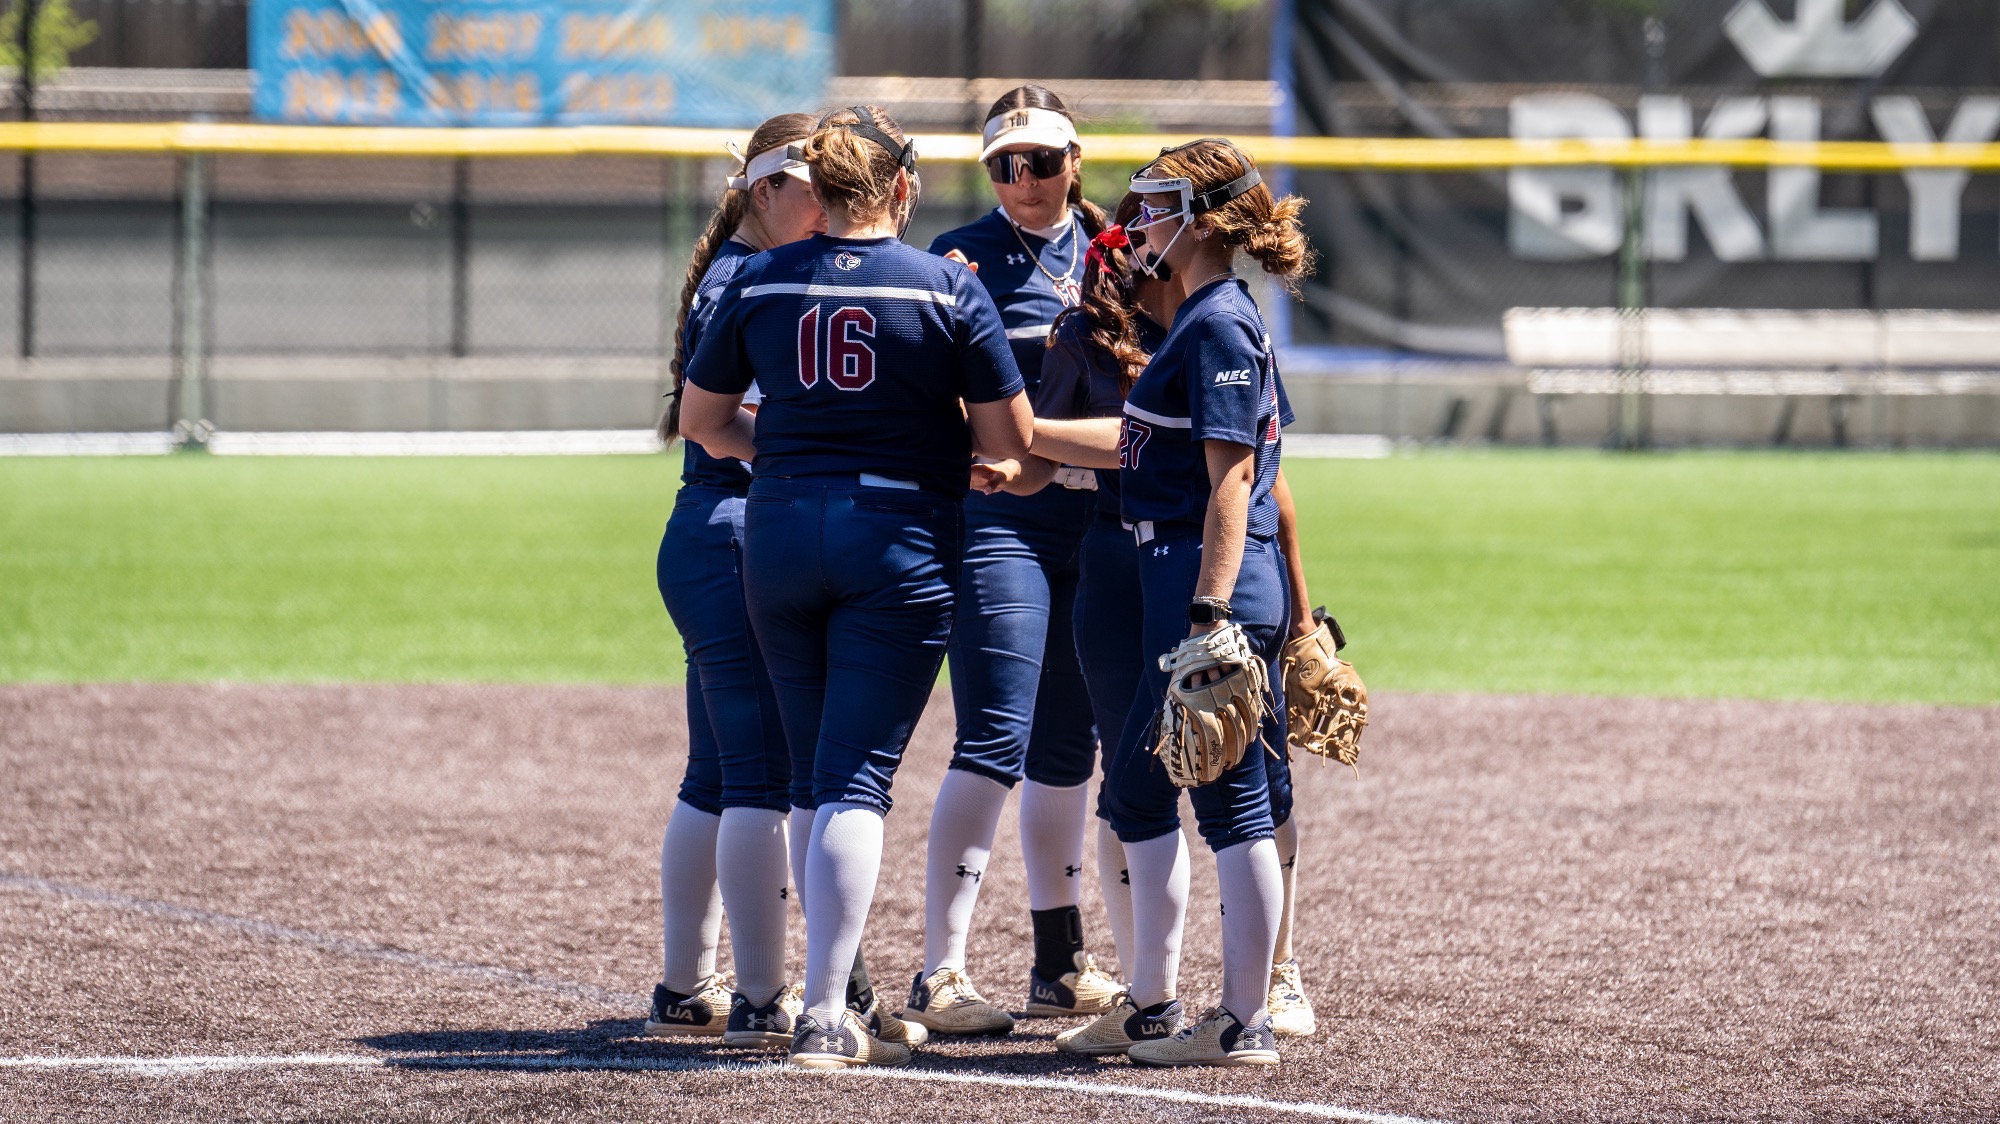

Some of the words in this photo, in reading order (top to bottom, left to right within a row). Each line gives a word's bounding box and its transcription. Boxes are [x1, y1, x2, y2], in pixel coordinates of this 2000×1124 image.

[797, 302, 877, 391] 16
[1214, 369, 1250, 382] NEC
[1034, 985, 1058, 1003] UA
[665, 1004, 695, 1022] UA
[1140, 1022, 1167, 1035] UA
